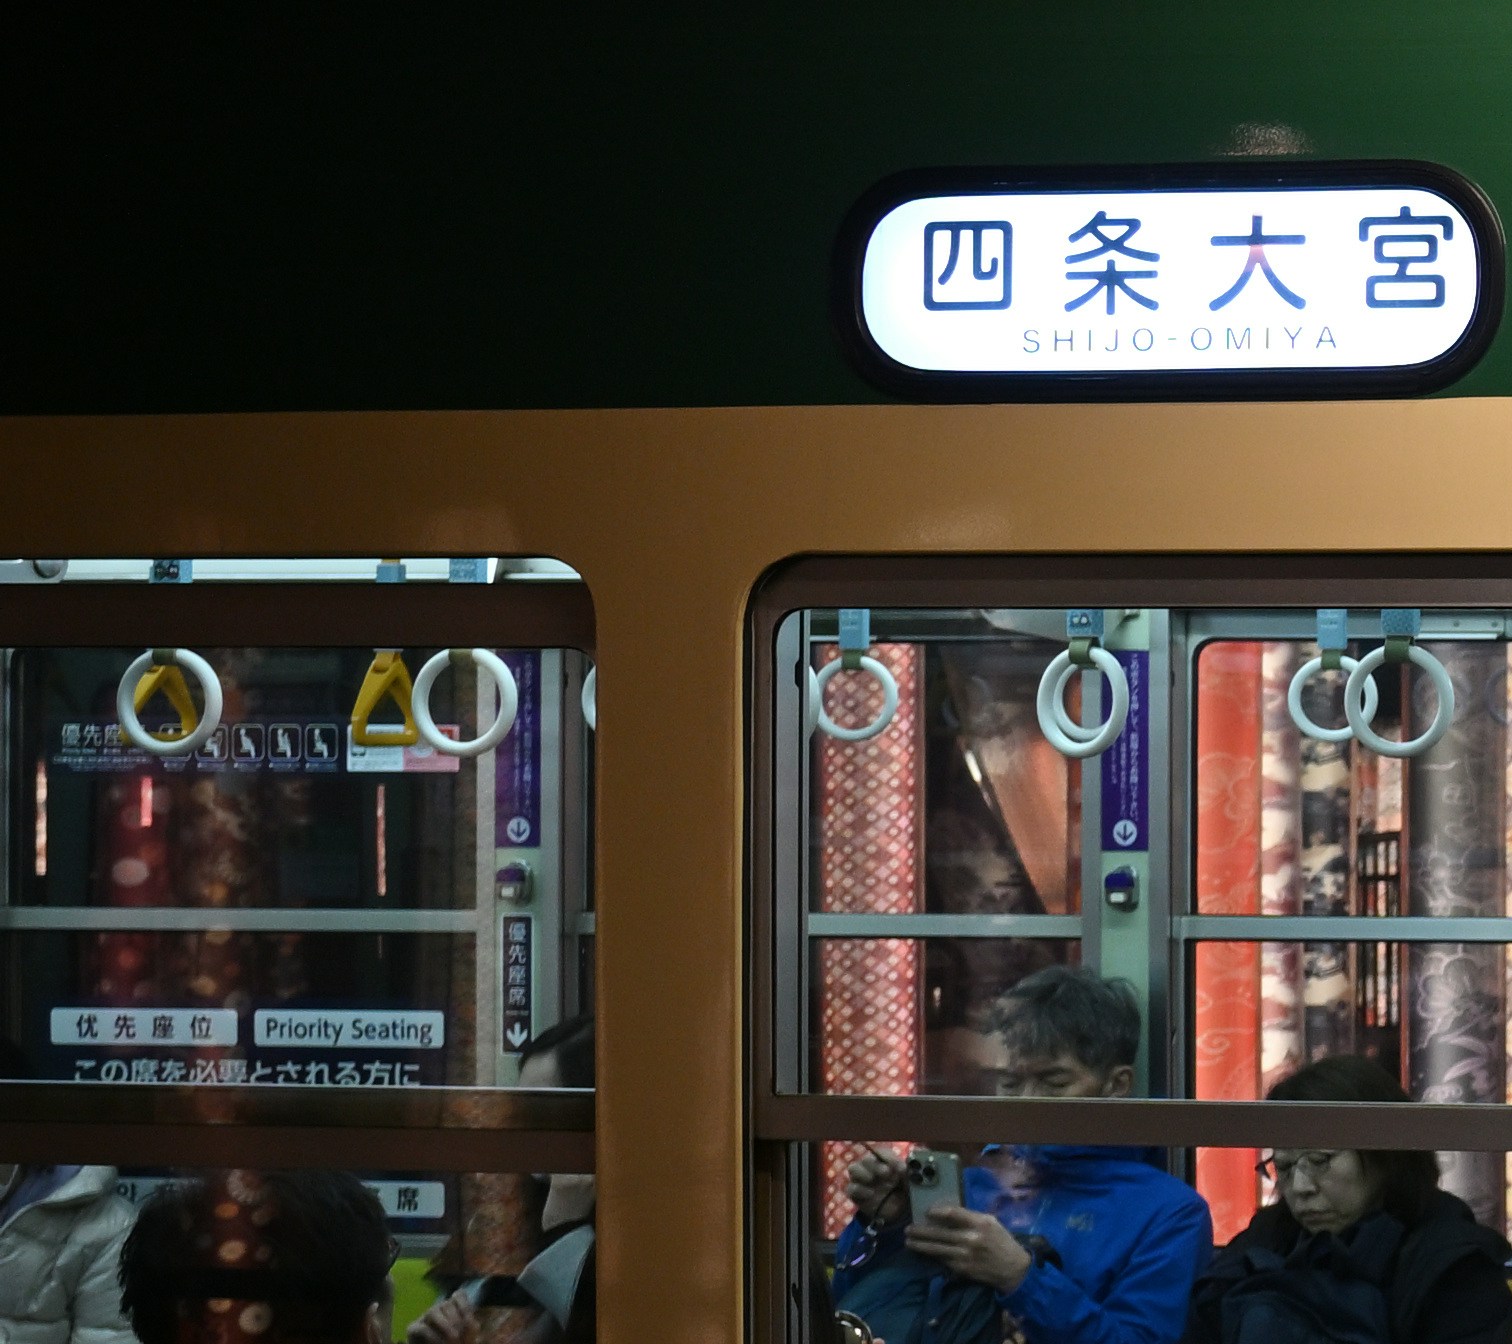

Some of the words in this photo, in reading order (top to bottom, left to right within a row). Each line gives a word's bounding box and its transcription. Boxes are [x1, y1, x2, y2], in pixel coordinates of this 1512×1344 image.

[922, 205, 1454, 316] 四条大宮
[1022, 325, 1338, 354] SHIJO-OMIYA
[508, 921, 527, 1007] 優先座席
[76, 1014, 213, 1040] 优先座位
[266, 1017, 344, 1046] Priority
[352, 1017, 433, 1047] Seating
